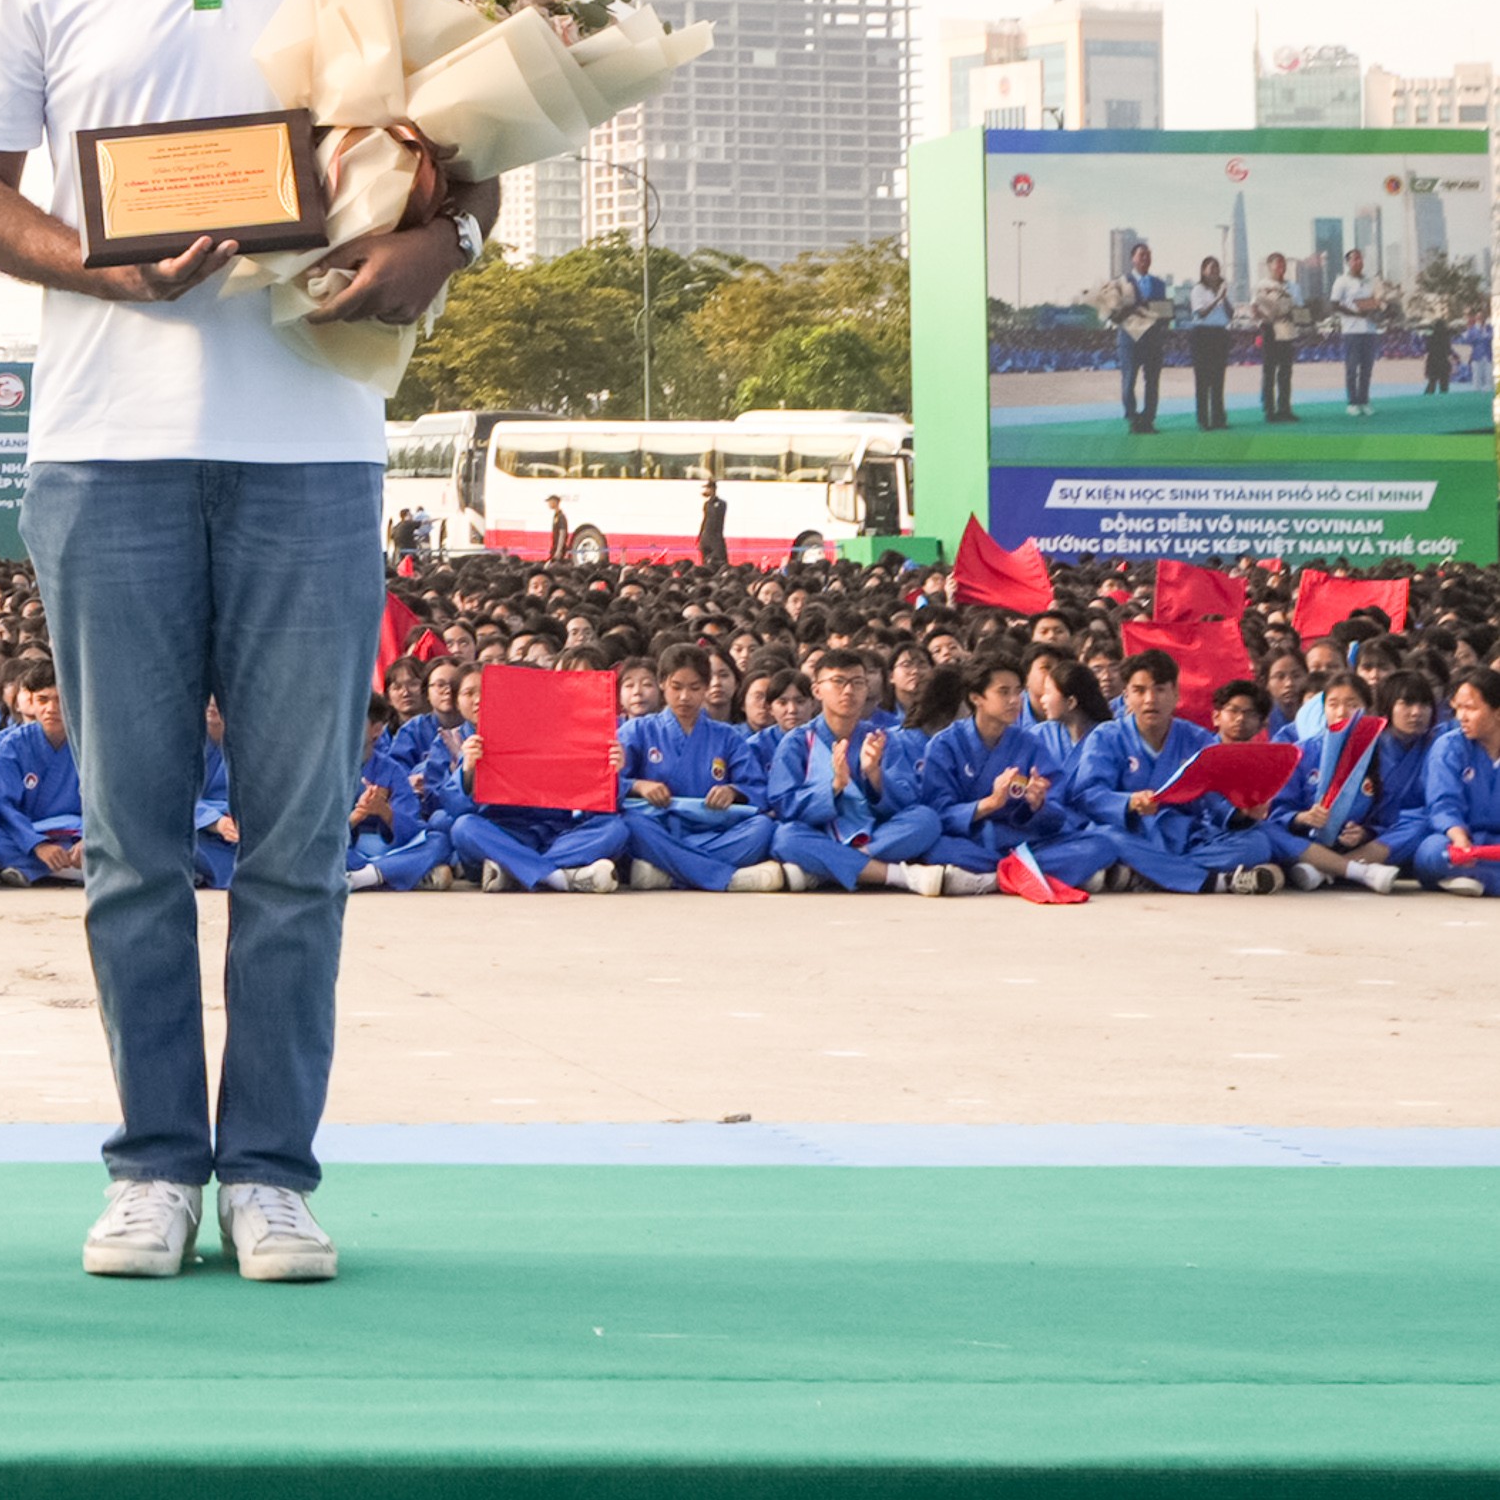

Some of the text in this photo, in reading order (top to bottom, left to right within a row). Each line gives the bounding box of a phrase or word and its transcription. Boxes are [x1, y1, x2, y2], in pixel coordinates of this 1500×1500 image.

[1059, 484, 1423, 505] SỰ KIỆN HỌC SINH THÀNH PHỐ HỒ CHÍ MINH
[1100, 511, 1155, 533] ĐỒNG
[1157, 511, 1202, 533] DIỄN
[1235, 518, 1290, 538] NHẠC
[1292, 518, 1384, 534] VOVINAM
[1102, 532, 1143, 553] ĐẾN
[1174, 537, 1210, 558] LỤC
[1213, 535, 1251, 554] KÉP
[1253, 536, 1300, 558] VIỆT
[1300, 539, 1343, 554] NAM
[1346, 536, 1373, 554] VÀ
[1377, 533, 1415, 554] THẾ
